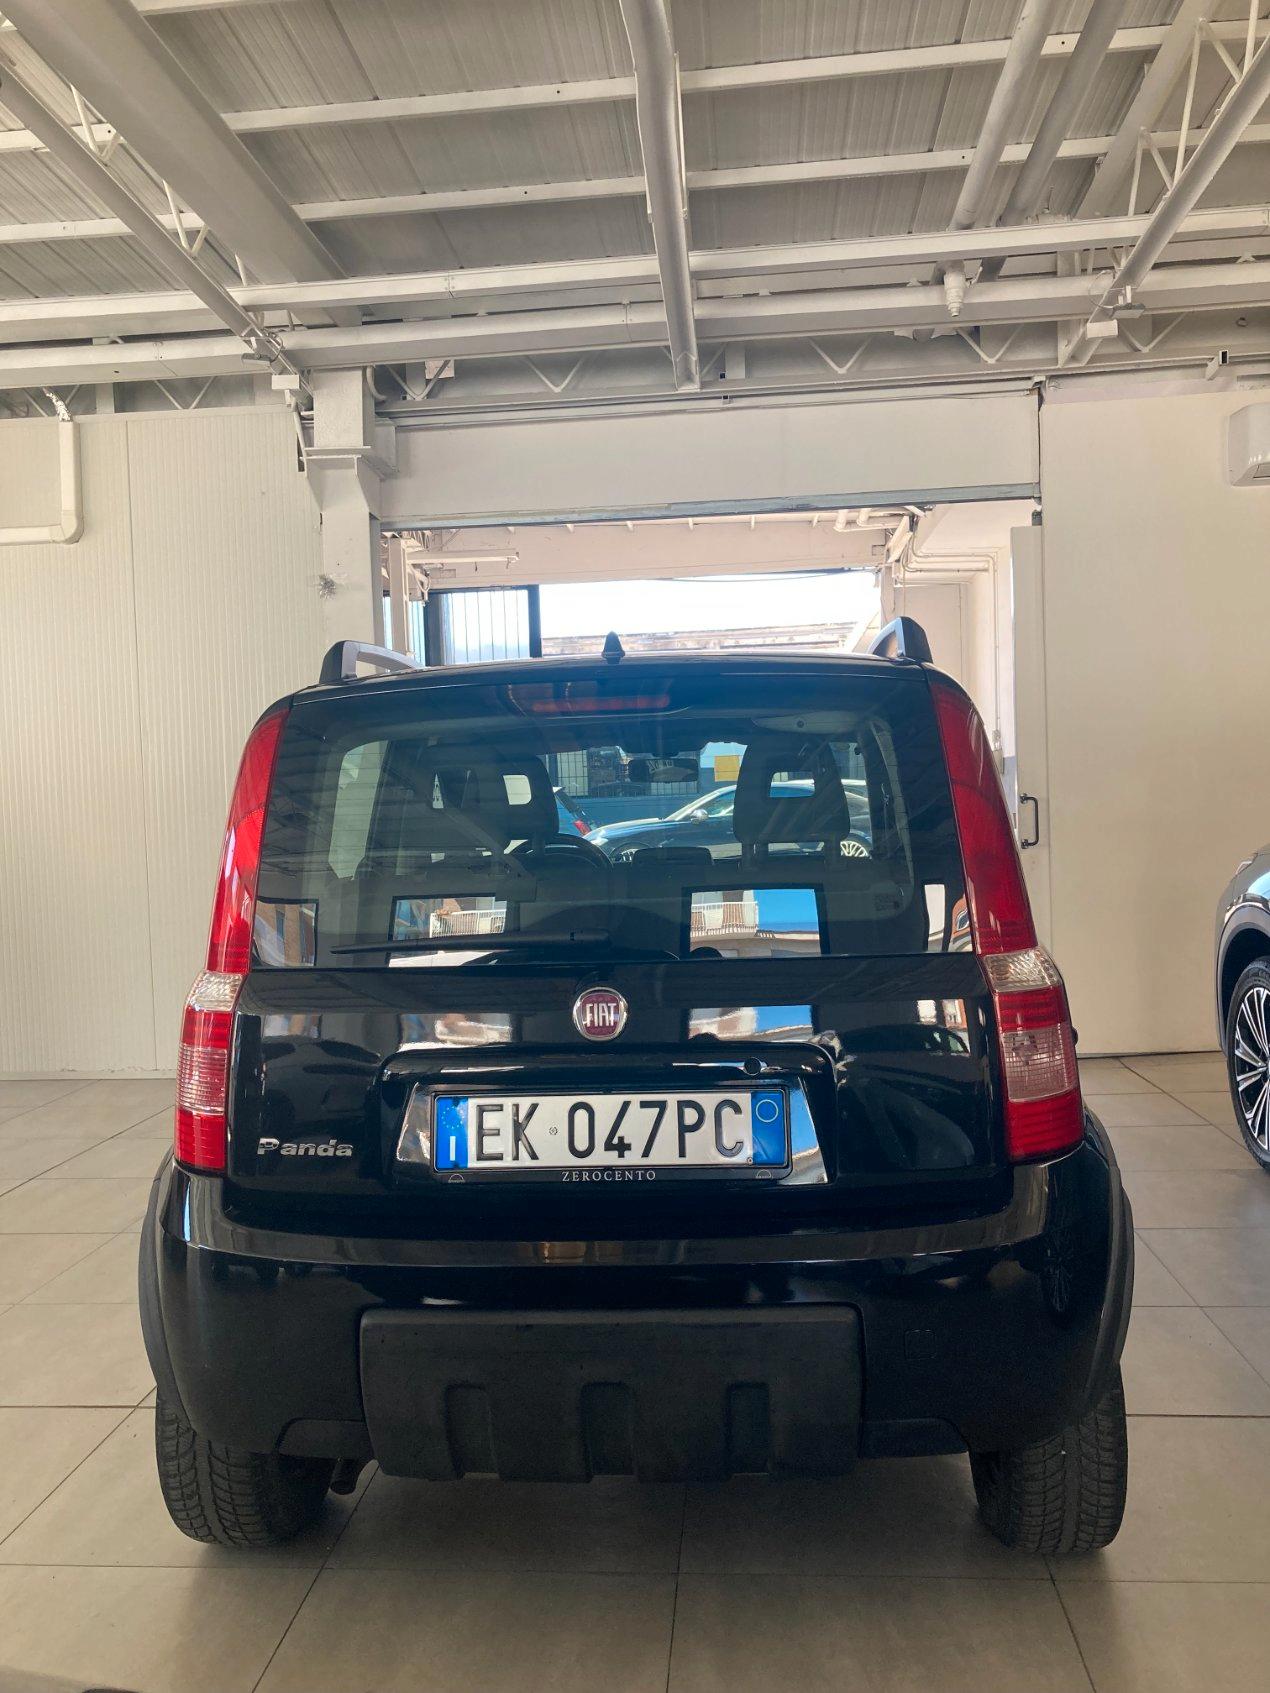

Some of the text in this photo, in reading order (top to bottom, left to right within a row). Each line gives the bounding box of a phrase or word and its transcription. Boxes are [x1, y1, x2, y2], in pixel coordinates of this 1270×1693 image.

[586, 1003, 617, 1027] FIAT
[476, 1099, 744, 1161] EK 047PC
[257, 1138, 353, 1156] Panda
[562, 1170, 656, 1182] ZEROCENTO
